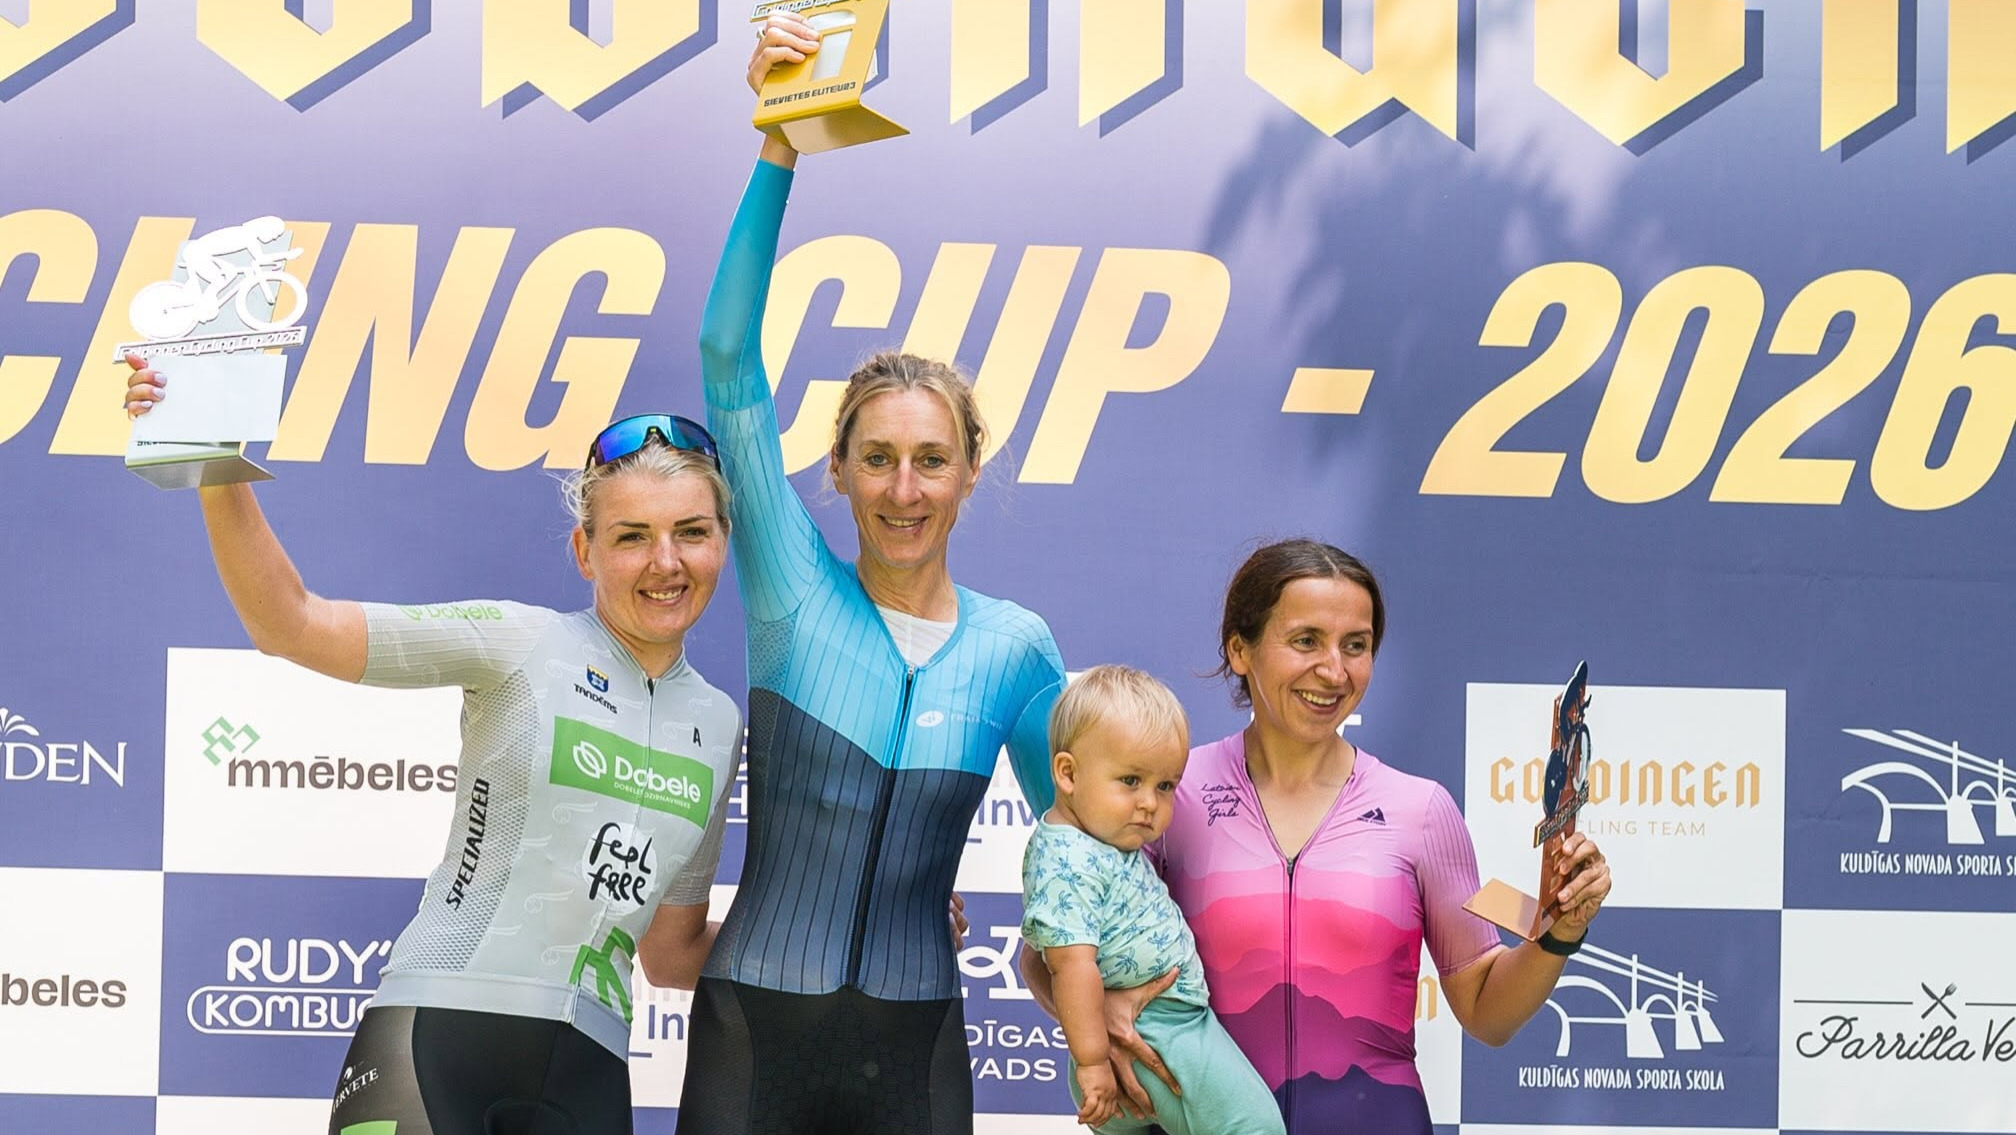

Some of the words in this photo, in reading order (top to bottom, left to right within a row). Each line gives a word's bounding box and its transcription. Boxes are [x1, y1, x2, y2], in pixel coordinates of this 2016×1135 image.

[764, 91, 811, 107] SIEVIETES
[760, 234, 1231, 485] CUP
[1281, 367, 1374, 414] -
[1419, 261, 2016, 511] 2026
[0, 740, 127, 788] DEN
[614, 755, 701, 803] Dobele
[1490, 757, 1760, 808] GODINGEN
[445, 778, 489, 911] SPECIALIZED
[1577, 820, 1637, 835] LING
[1648, 821, 1706, 836] TEAM
[1840, 850, 1900, 874] KULDĪGAS
[1905, 853, 1953, 875] NOVADA
[1957, 855, 2002, 876] SPORTA
[1796, 1015, 1976, 1061] Parrilla
[1519, 1065, 1579, 1088] KULDĪGAS
[1584, 1068, 1632, 1089] NOVADA
[1636, 1069, 1682, 1090] SPORTA
[1686, 1069, 1725, 1091] SKOLA
